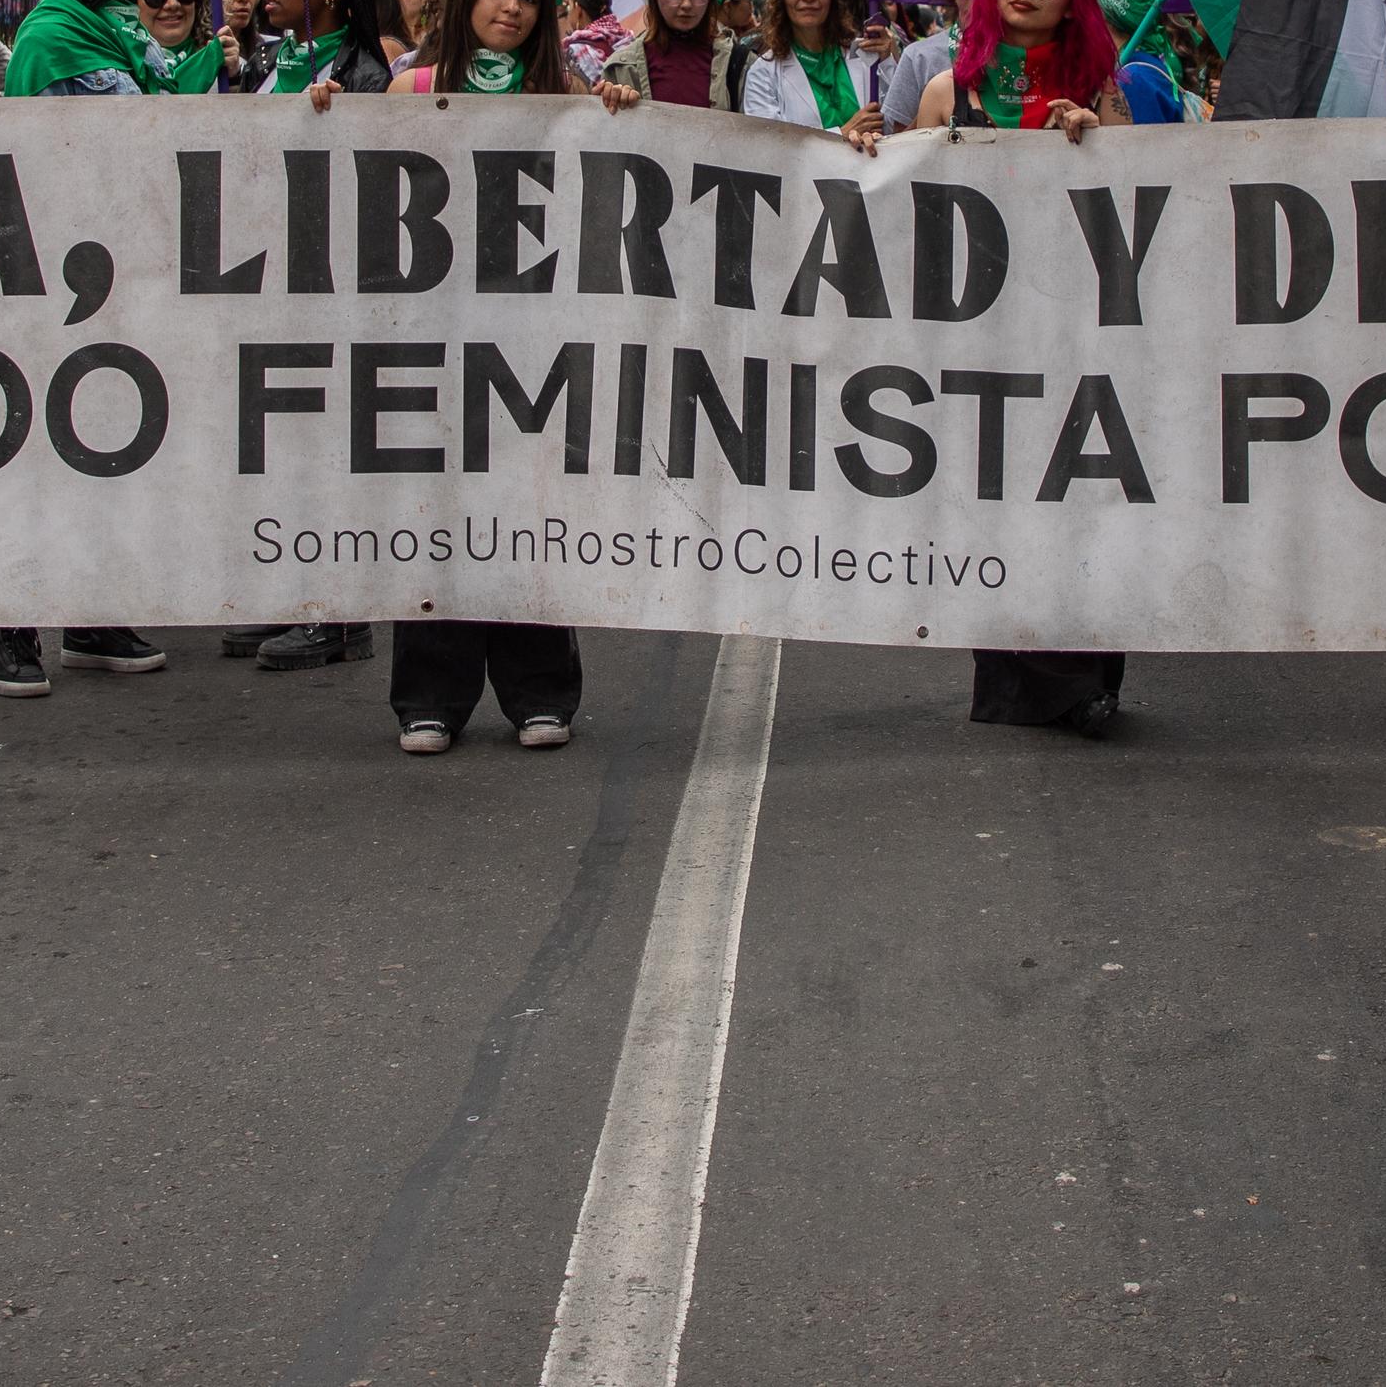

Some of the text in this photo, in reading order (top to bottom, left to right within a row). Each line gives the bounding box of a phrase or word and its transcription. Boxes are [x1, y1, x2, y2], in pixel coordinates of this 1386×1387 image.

[176, 150, 1009, 322] LIBERTAD
[1068, 186, 1171, 326] Y
[239, 343, 1155, 503] FEMINISTA
[253, 517, 1006, 589] SomosUnRostroColectivo
